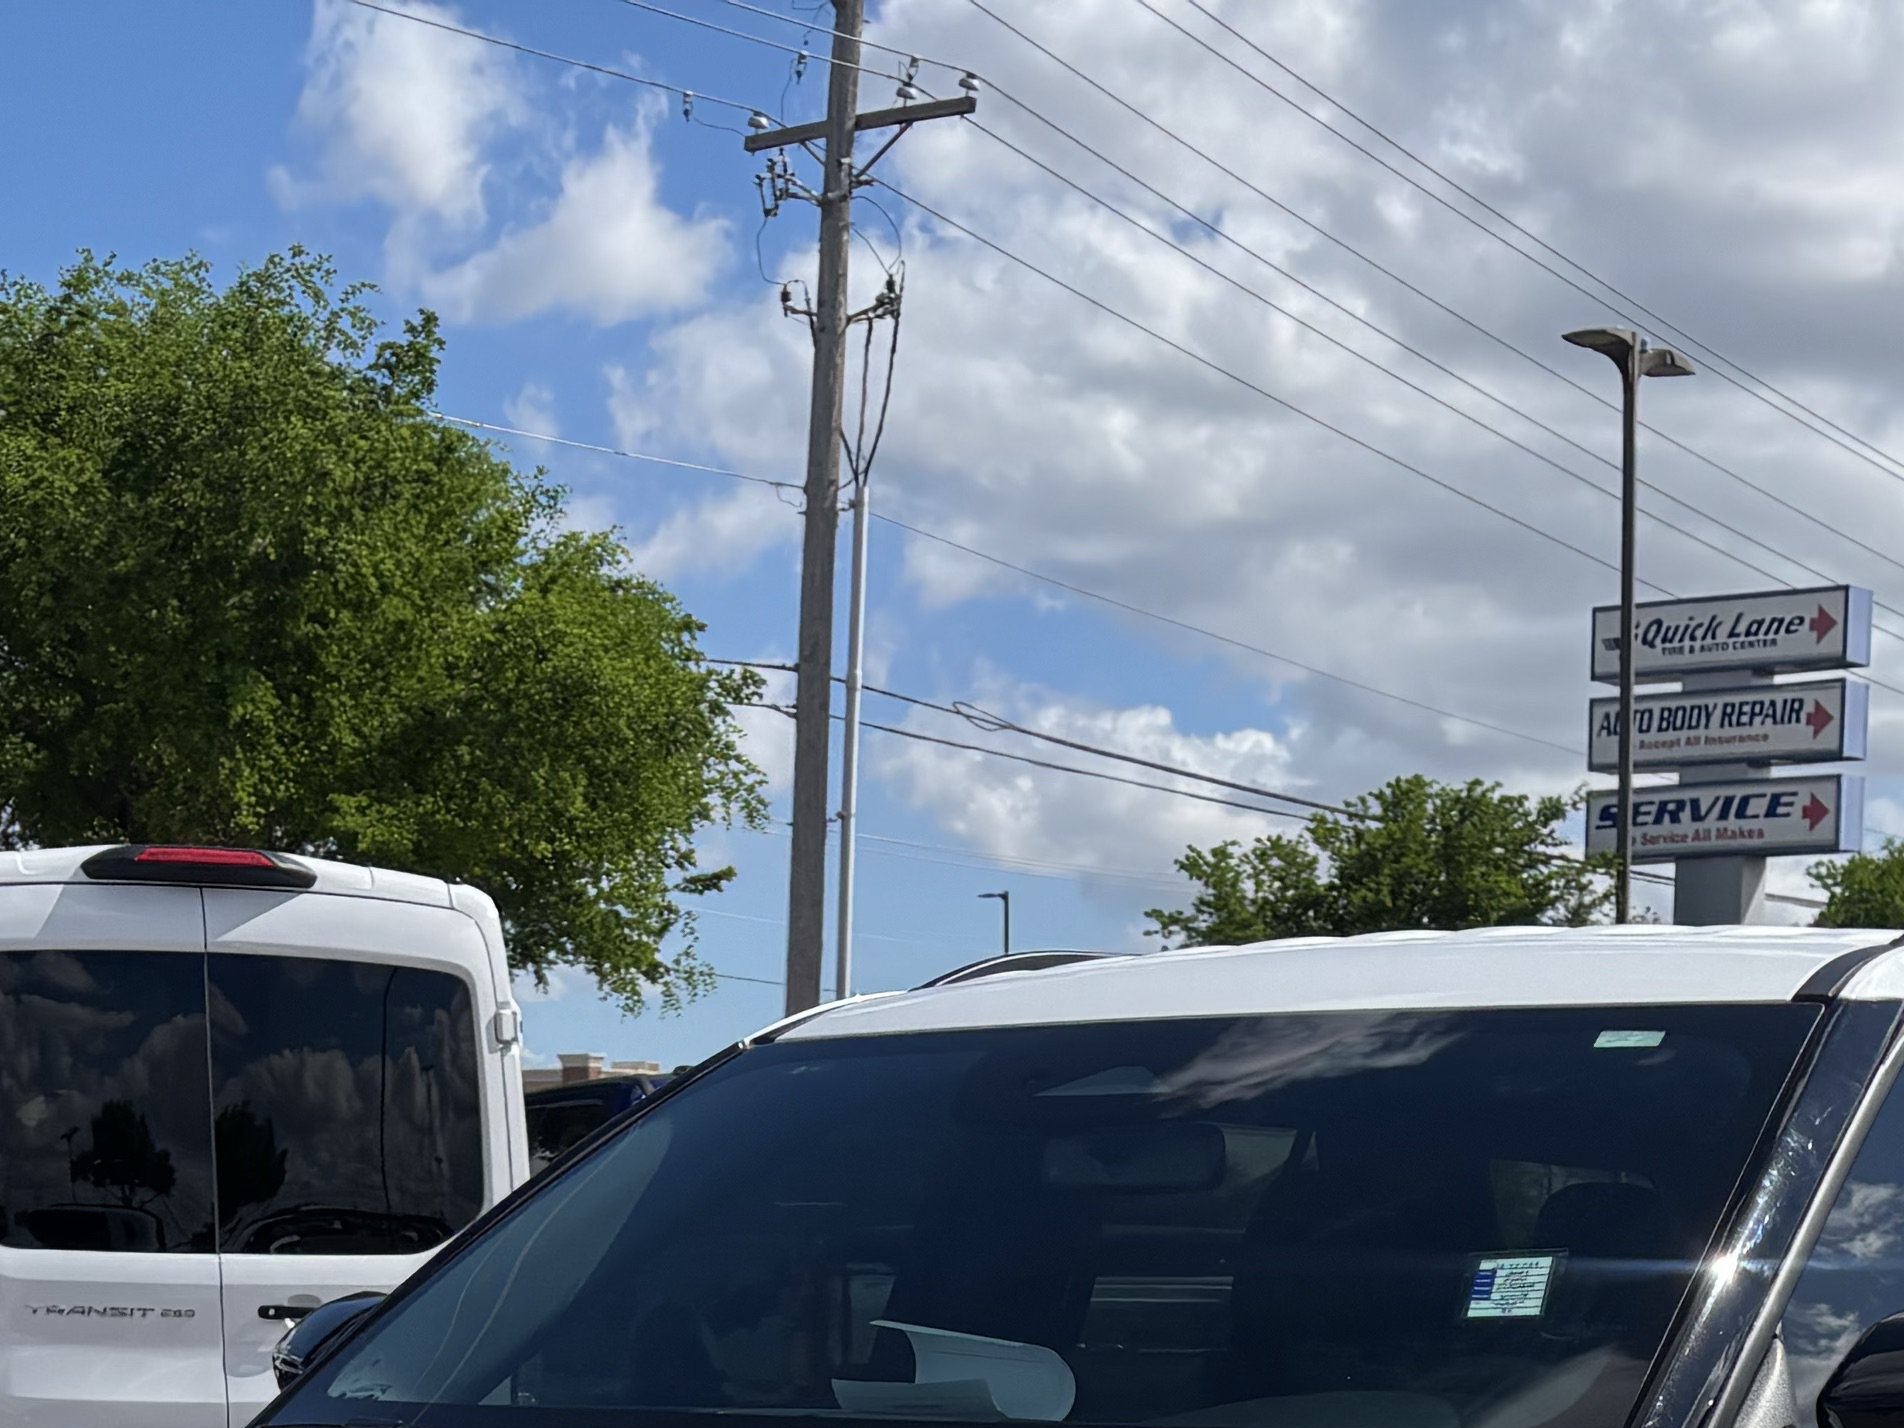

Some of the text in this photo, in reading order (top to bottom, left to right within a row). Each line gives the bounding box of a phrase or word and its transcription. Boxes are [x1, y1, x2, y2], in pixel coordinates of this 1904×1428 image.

[1642, 612, 1806, 649] Quick Lane
[1700, 642, 1729, 653] AUTO
[1732, 638, 1778, 651] CENTER
[1657, 703, 1717, 734] BODY
[1720, 698, 1804, 729] REPAIR
[1595, 792, 1799, 830] SERVICE
[1641, 832, 1688, 846] Service
[1691, 828, 1711, 842] All
[1716, 826, 1764, 840] Makes
[24, 1304, 156, 1318] TRANSIT
